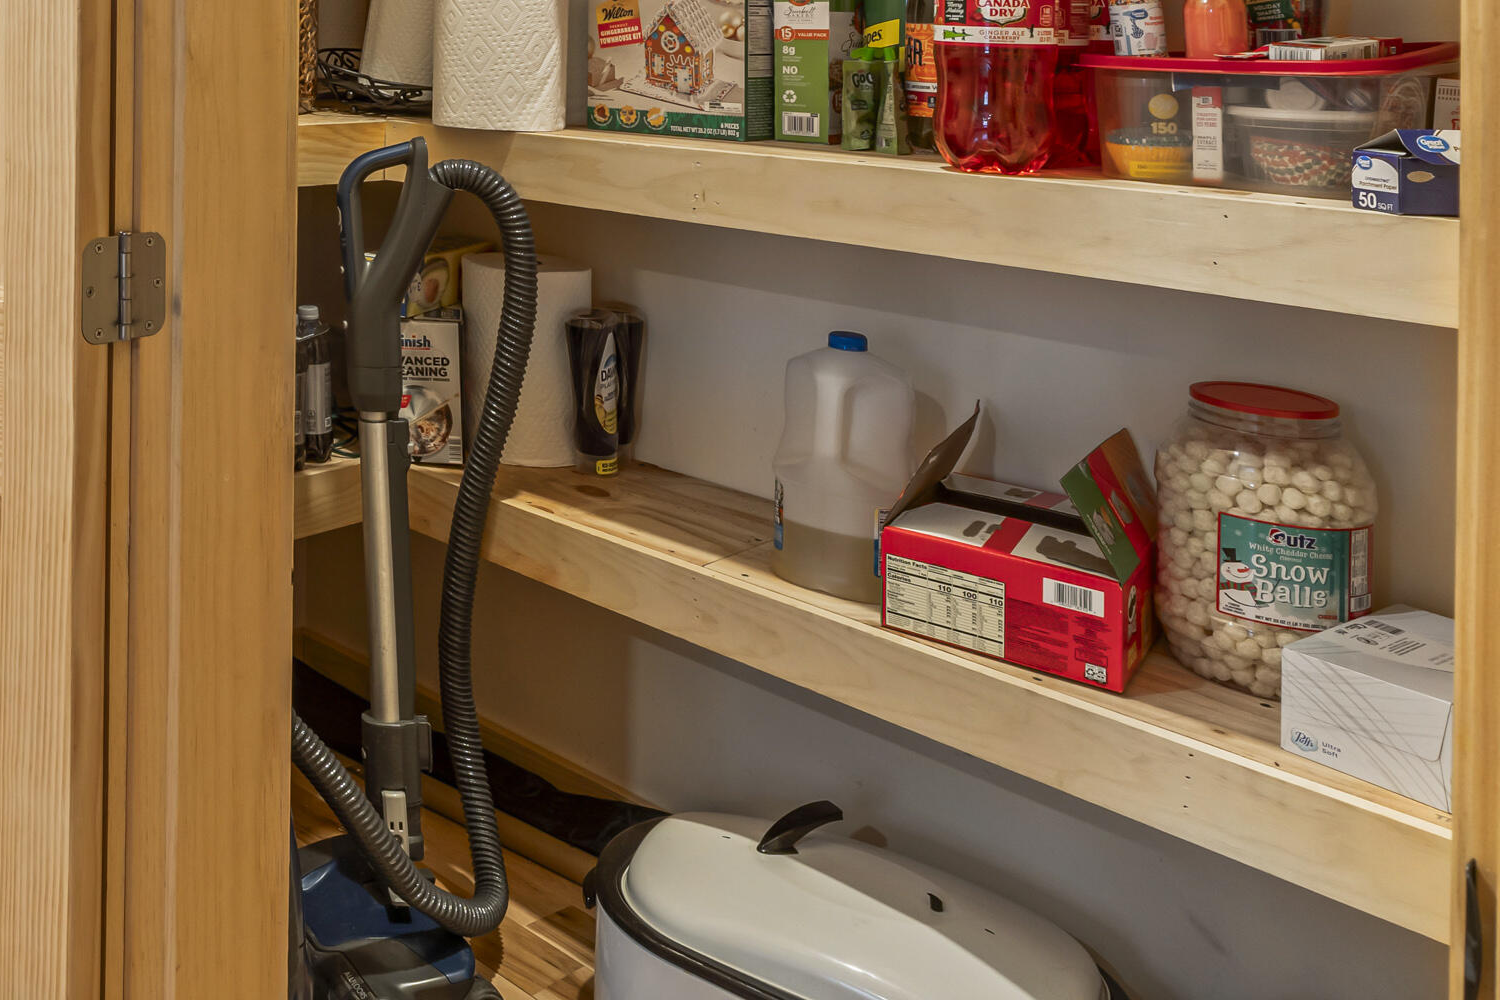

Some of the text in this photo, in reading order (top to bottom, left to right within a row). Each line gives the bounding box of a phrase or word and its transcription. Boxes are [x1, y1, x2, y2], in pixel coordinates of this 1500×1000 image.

[602, 6, 634, 21] Wilton
[989, 8, 1017, 17] DRY
[600, 25, 639, 37] GINGERBREAD
[781, 28, 792, 39] 15
[600, 32, 641, 46] TOWNHOUSE KIT
[782, 46, 796, 56] 8g
[782, 65, 798, 75] NO
[1150, 121, 1178, 135] 150
[1383, 182, 1397, 190] Paper
[1358, 191, 1394, 211] 50 SQ FT
[400, 334, 431, 348] inish
[400, 366, 448, 377] EANING
[1249, 541, 1333, 560] White Cheddar Cheese
[887, 555, 928, 570] Nutrition Facts
[1250, 554, 1330, 585] Snow
[887, 572, 912, 583] Calories
[938, 584, 1004, 607] 110 100 110
[1256, 579, 1329, 608] Balls
[1321, 741, 1342, 752] Ultra
[1321, 748, 1338, 758] Soft
